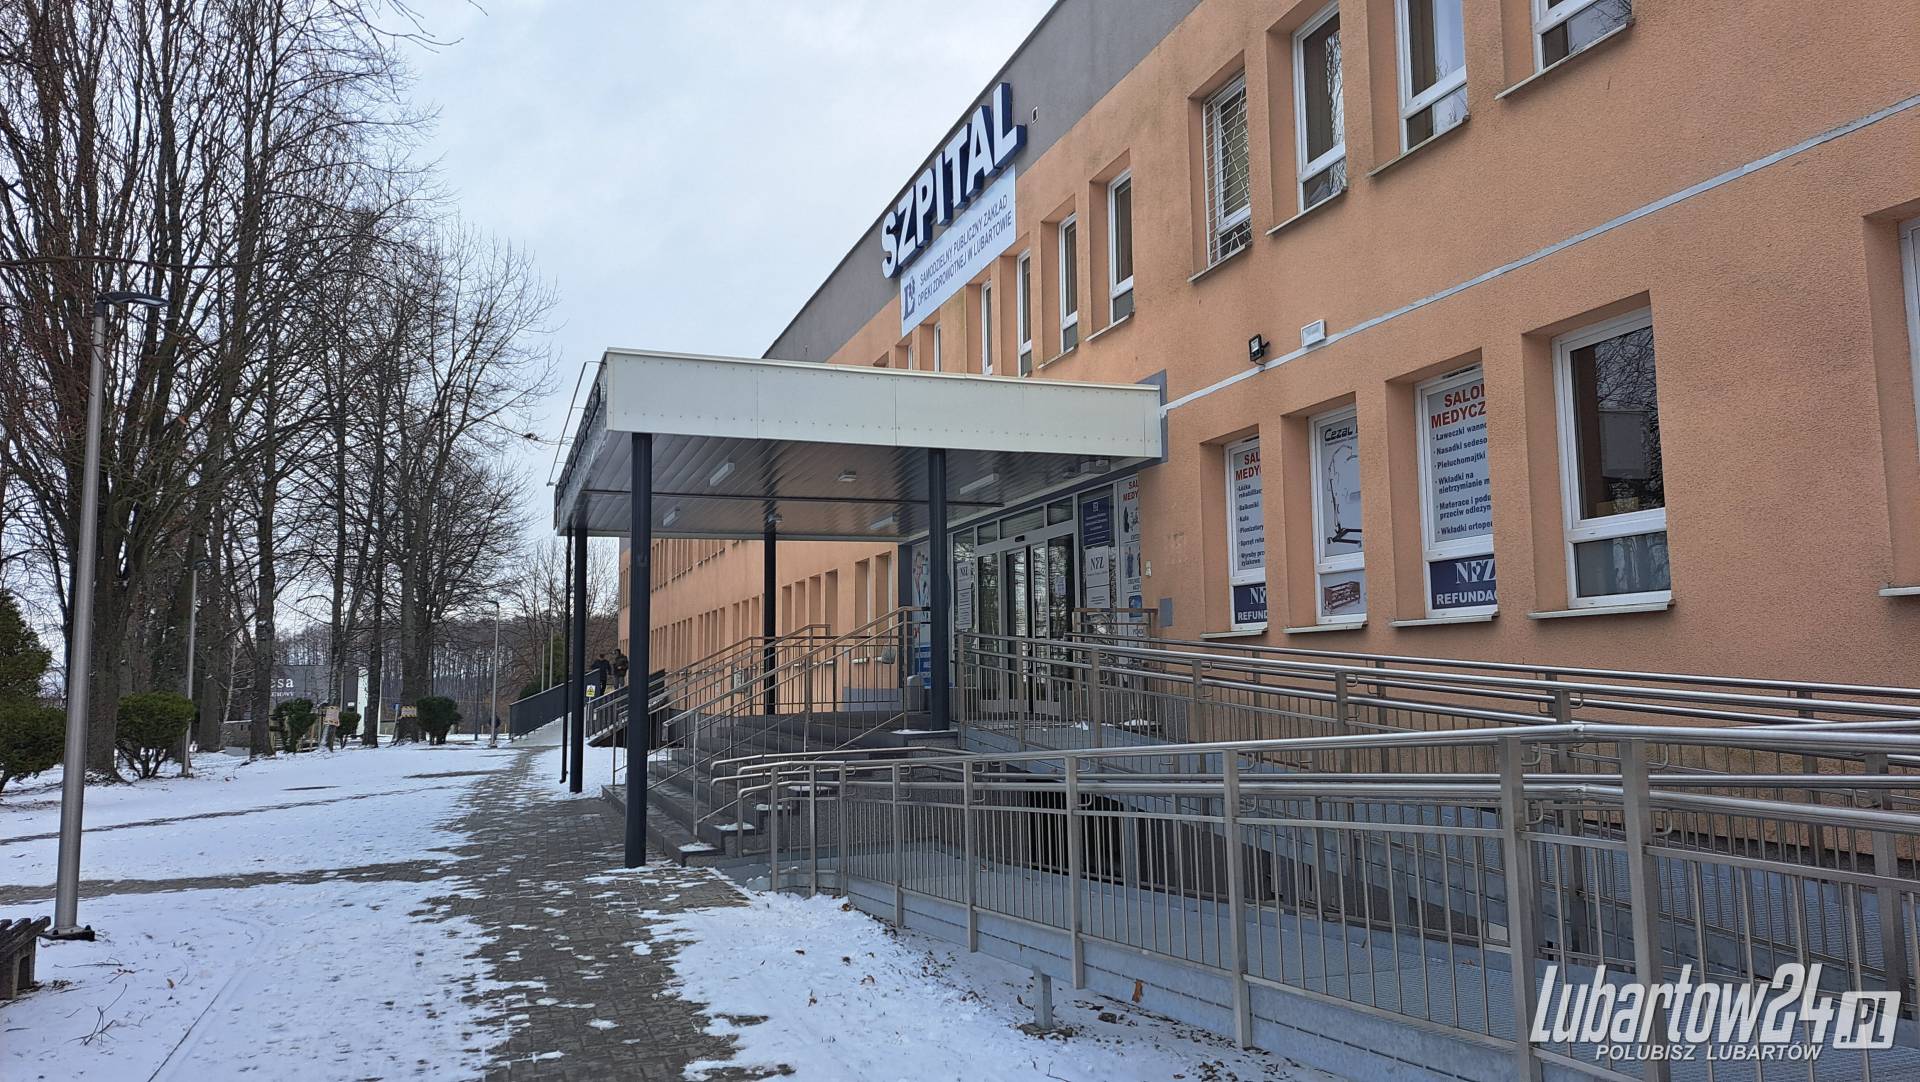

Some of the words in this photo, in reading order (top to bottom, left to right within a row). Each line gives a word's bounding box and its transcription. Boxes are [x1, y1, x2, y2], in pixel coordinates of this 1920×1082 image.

[882, 82, 1026, 279] SZPITAL
[920, 248, 953, 286] SAMODZIELNY
[953, 218, 983, 255] PUBLICZNY
[983, 194, 1008, 227] ZAKŁAD
[918, 284, 933, 306] OPIEKI
[933, 253, 967, 294] ZDROWOTNEJ
[967, 247, 973, 261] W
[973, 211, 1012, 256] LUBARTOWIE
[1431, 401, 1487, 429] MEDYCZ
[1437, 442, 1463, 455] Nasadki
[1244, 451, 1261, 465] SAL
[1437, 450, 1486, 469] Pieluchomajtki
[1235, 465, 1262, 481] MEDY
[1439, 472, 1465, 485] Wkładki
[1440, 498, 1470, 510] Materace
[1440, 508, 1464, 521] przeciw
[1455, 559, 1496, 584] NFZ
[1436, 590, 1497, 605] REFUNDA
